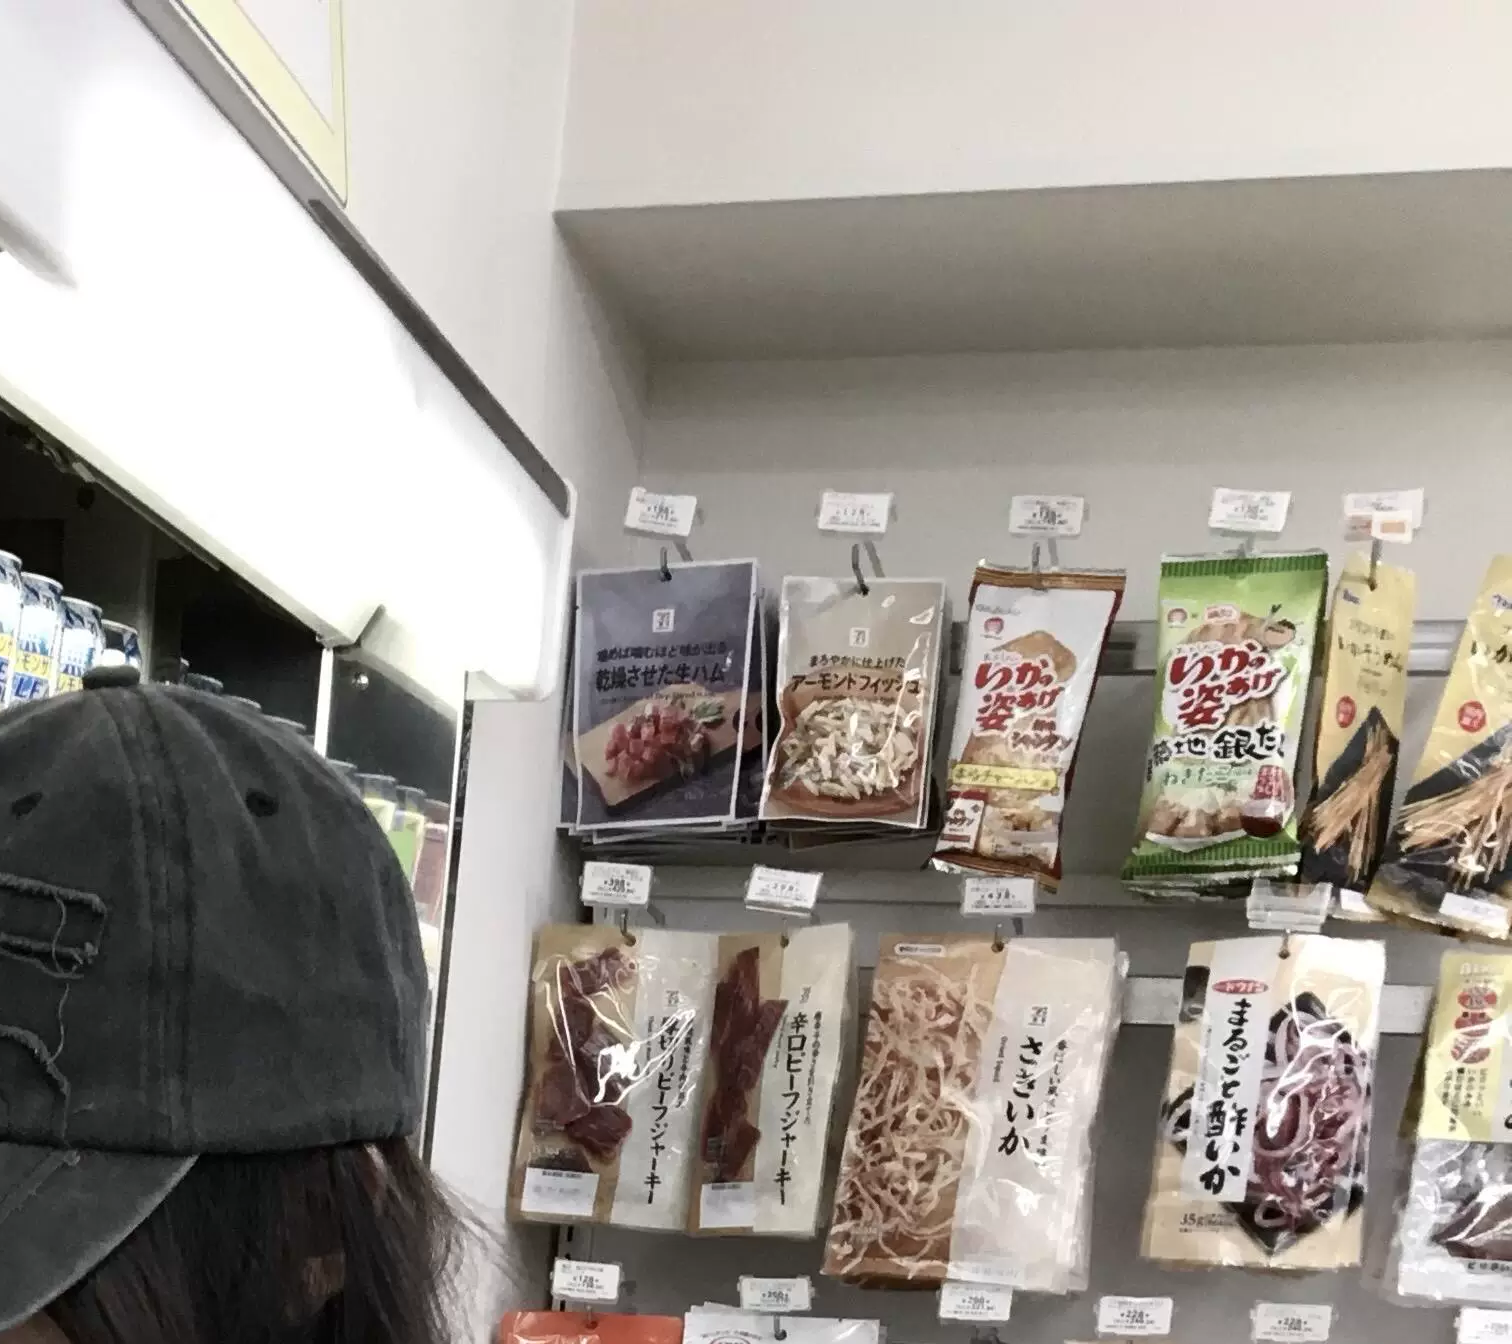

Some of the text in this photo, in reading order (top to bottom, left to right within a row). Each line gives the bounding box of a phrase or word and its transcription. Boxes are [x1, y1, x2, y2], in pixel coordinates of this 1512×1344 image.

[596, 663, 725, 693] 乾燥させた生ハム
[791, 672, 922, 693] アーモンドフィッシュ
[1169, 643, 1267, 686] いかの
[1177, 667, 1282, 728] 姿あげ
[773, 1012, 809, 1206] 辛口ビーフジャーキー
[998, 1036, 1045, 1158] さきいか
[1198, 997, 1252, 1196] まるごと酢いか
